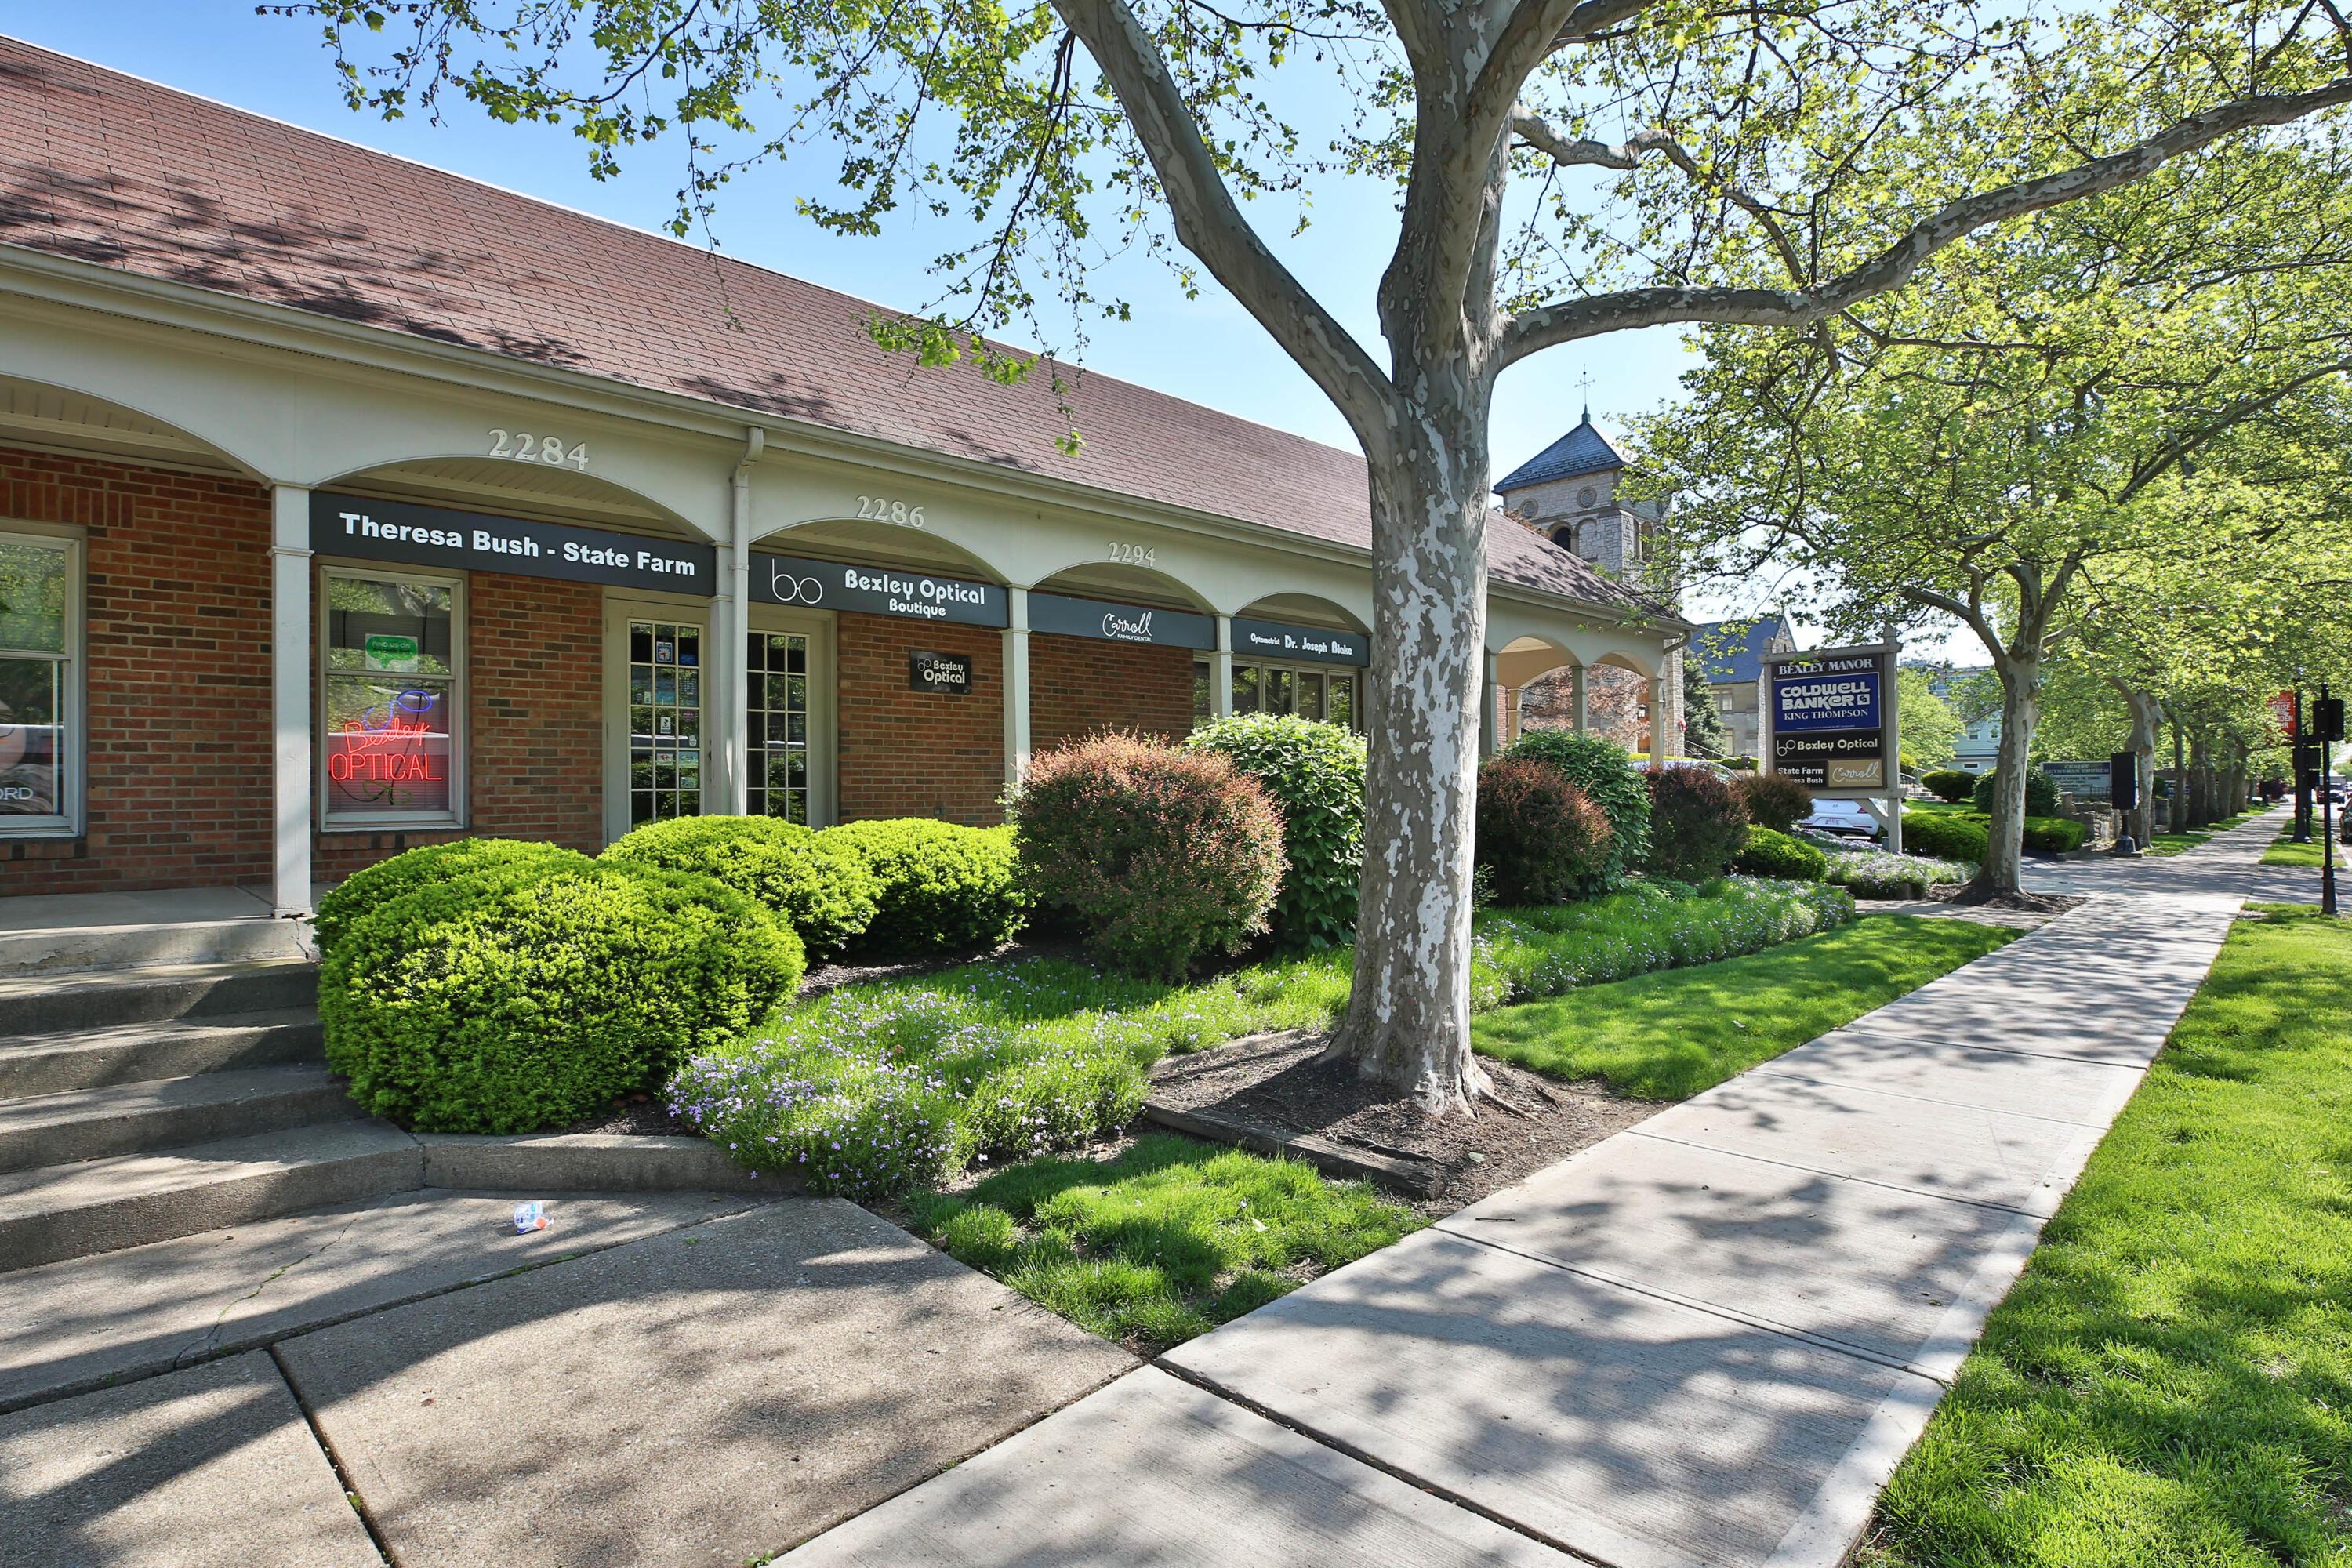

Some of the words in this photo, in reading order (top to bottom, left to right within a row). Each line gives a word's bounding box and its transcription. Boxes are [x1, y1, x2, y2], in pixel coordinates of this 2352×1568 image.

[488, 429, 588, 470] 2284
[856, 495, 924, 528] 2286
[339, 512, 463, 548] Theresa
[473, 530, 539, 557] Bush
[564, 542, 630, 568] State
[637, 551, 695, 576] Farm
[1109, 542, 1156, 567] 2294
[844, 569, 913, 601] Bexley
[920, 579, 985, 604] Optical
[889, 598, 946, 619] Boutique
[1102, 612, 1152, 637] Carroll
[1250, 633, 1281, 645] Optometrist
[1284, 635, 1298, 649] Dr.
[1302, 637, 1328, 655] Joseph
[1331, 641, 1353, 655] Blake
[924, 669, 965, 685] Optical
[933, 660, 964, 673] Bexley
[1779, 662, 1825, 674] BEXLEY
[1828, 659, 1874, 672] MANOR
[1784, 712, 1809, 720] KING
[1811, 709, 1868, 719] THOMPSON
[344, 717, 430, 753] Bexley
[1798, 741, 1834, 752] Bexley
[1837, 739, 1878, 751] Optical
[331, 753, 442, 780] OPTICAL
[1832, 761, 1879, 782] Carroll
